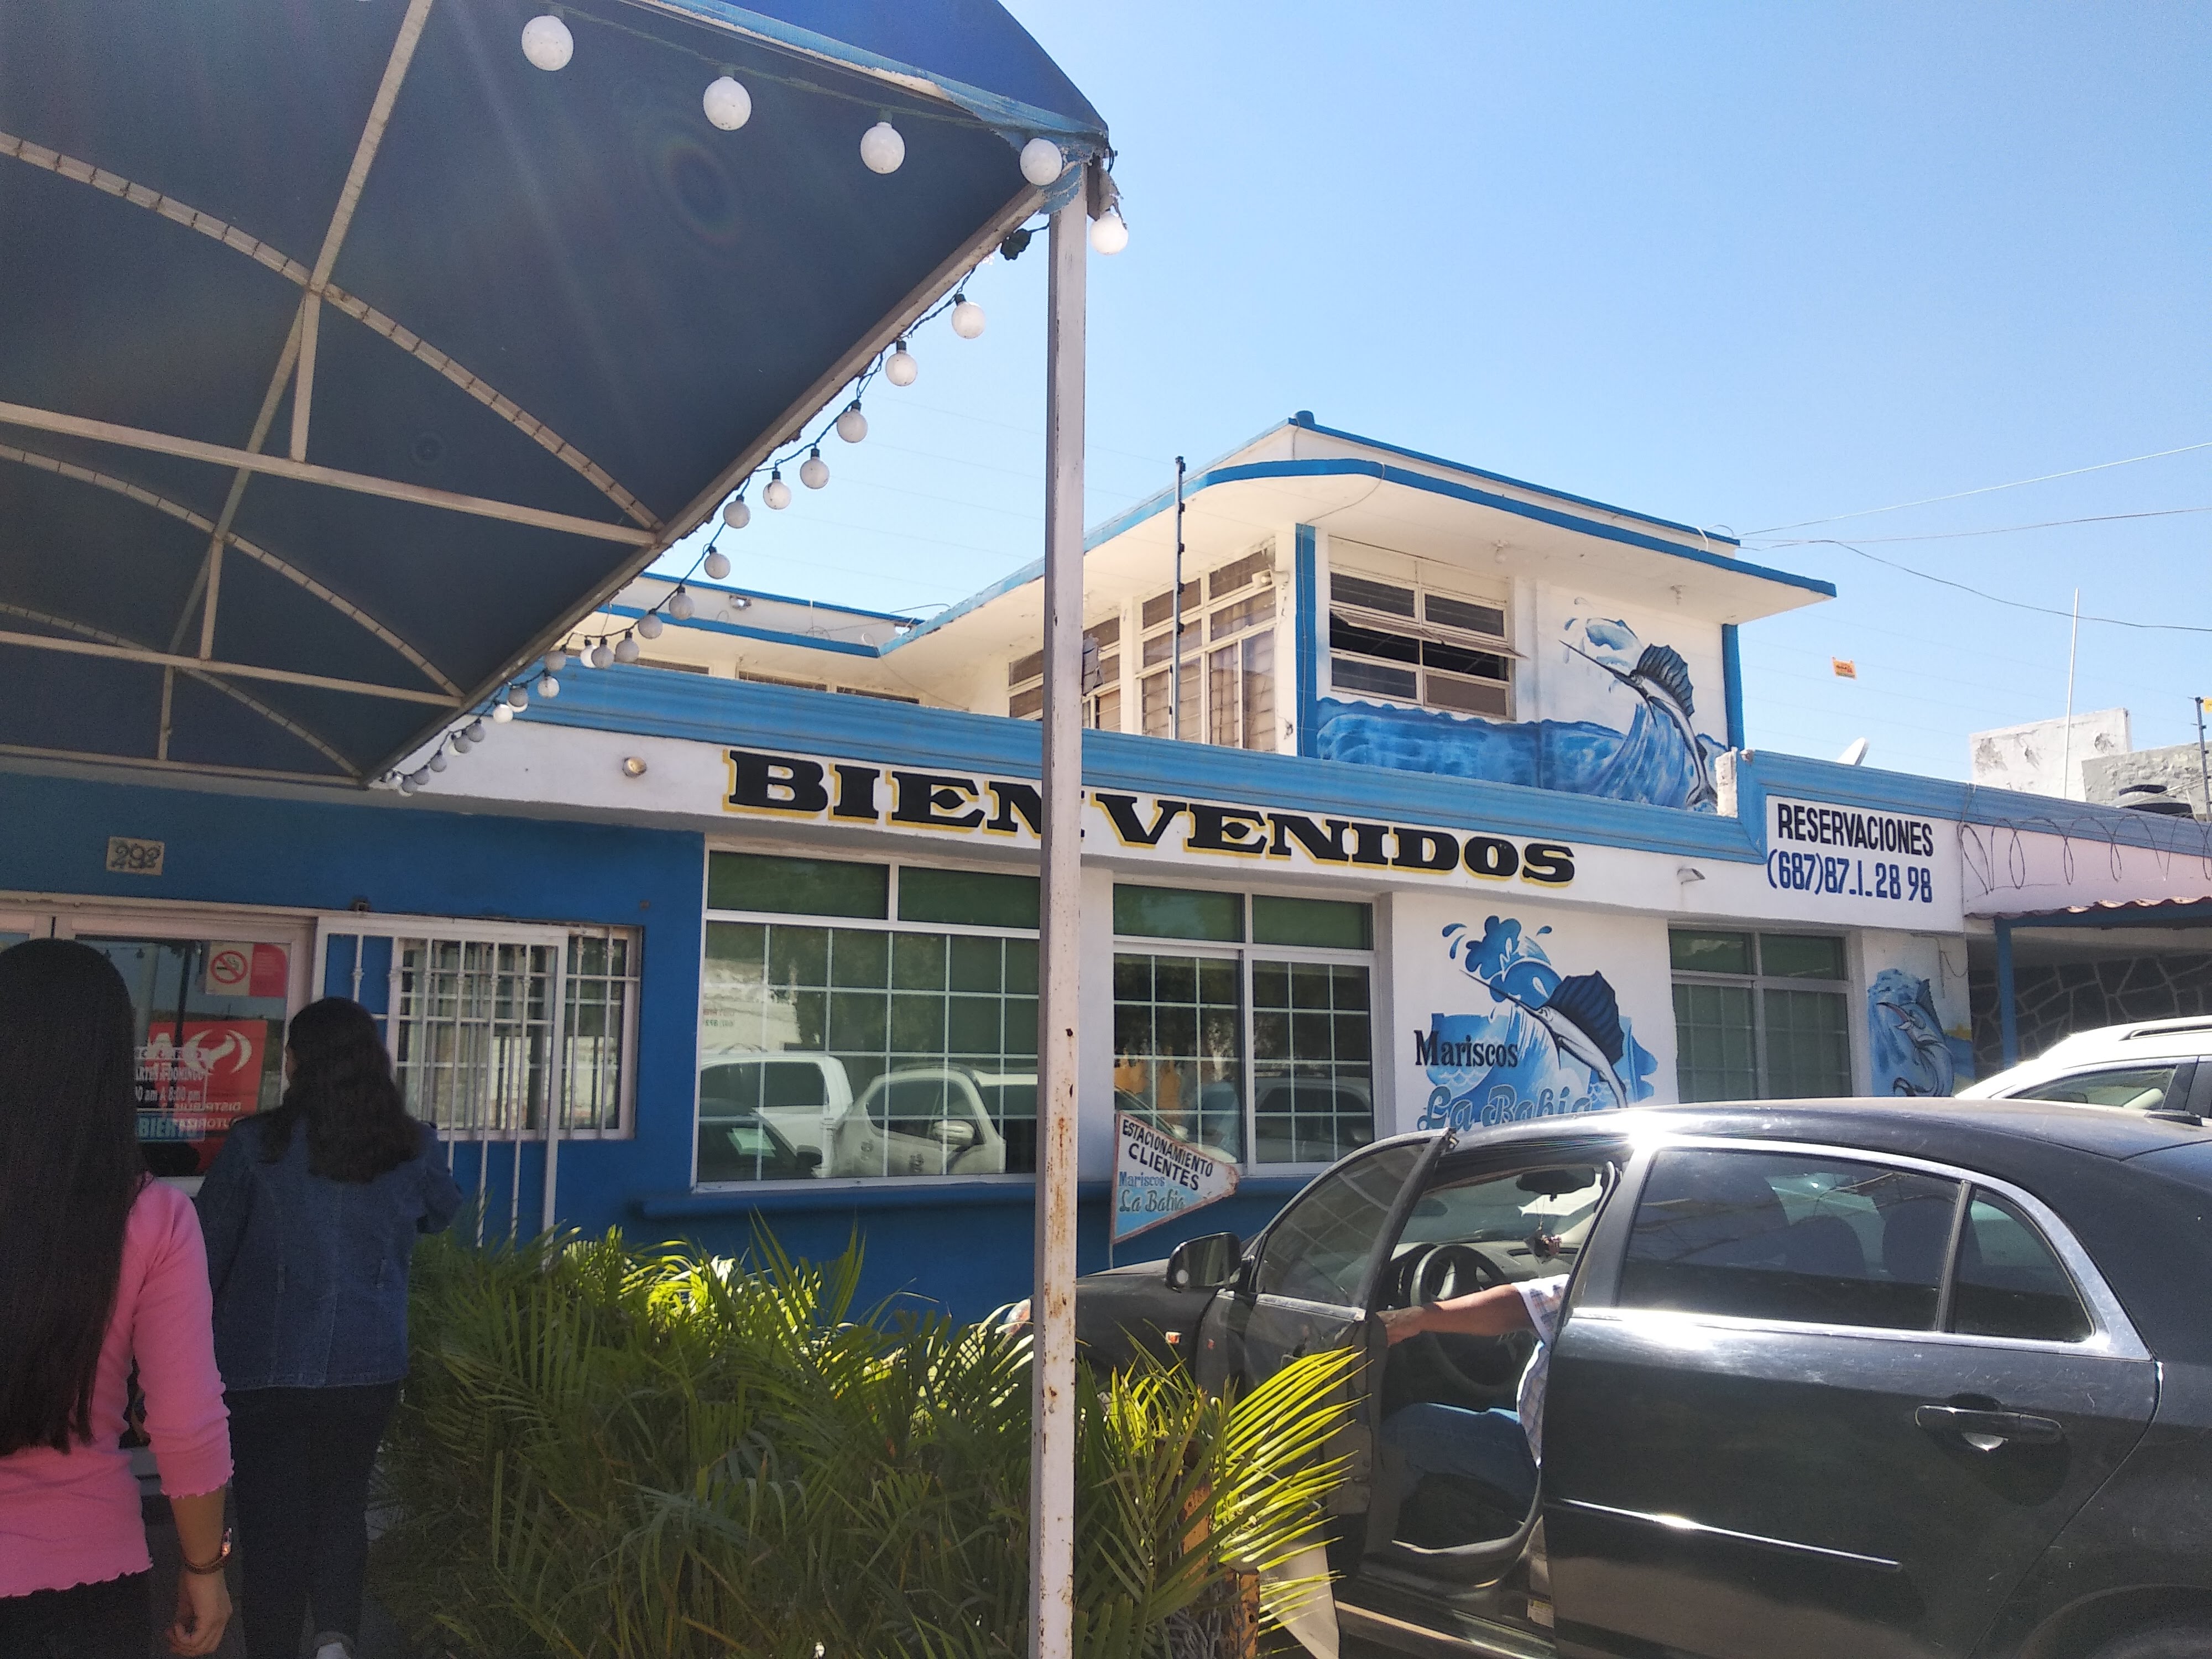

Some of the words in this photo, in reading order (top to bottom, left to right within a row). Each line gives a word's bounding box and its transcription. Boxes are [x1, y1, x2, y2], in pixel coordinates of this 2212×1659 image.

[723, 748, 1575, 888] BIENVENIDOS
[1777, 803, 1934, 857] RESERVACIONES
[1413, 1030, 1518, 1068] Mariscos
[135, 1066, 159, 1081] ARTES
[145, 1089, 158, 1102] am
[1416, 1084, 1476, 1132] La
[138, 1117, 200, 1138] BIERTO
[1123, 1119, 1214, 1177] ESTACIONAMIENTO
[1129, 1142, 1199, 1191] CLIENTES
[1119, 1170, 1166, 1187] Mariscos
[1119, 1190, 1142, 1213] La
